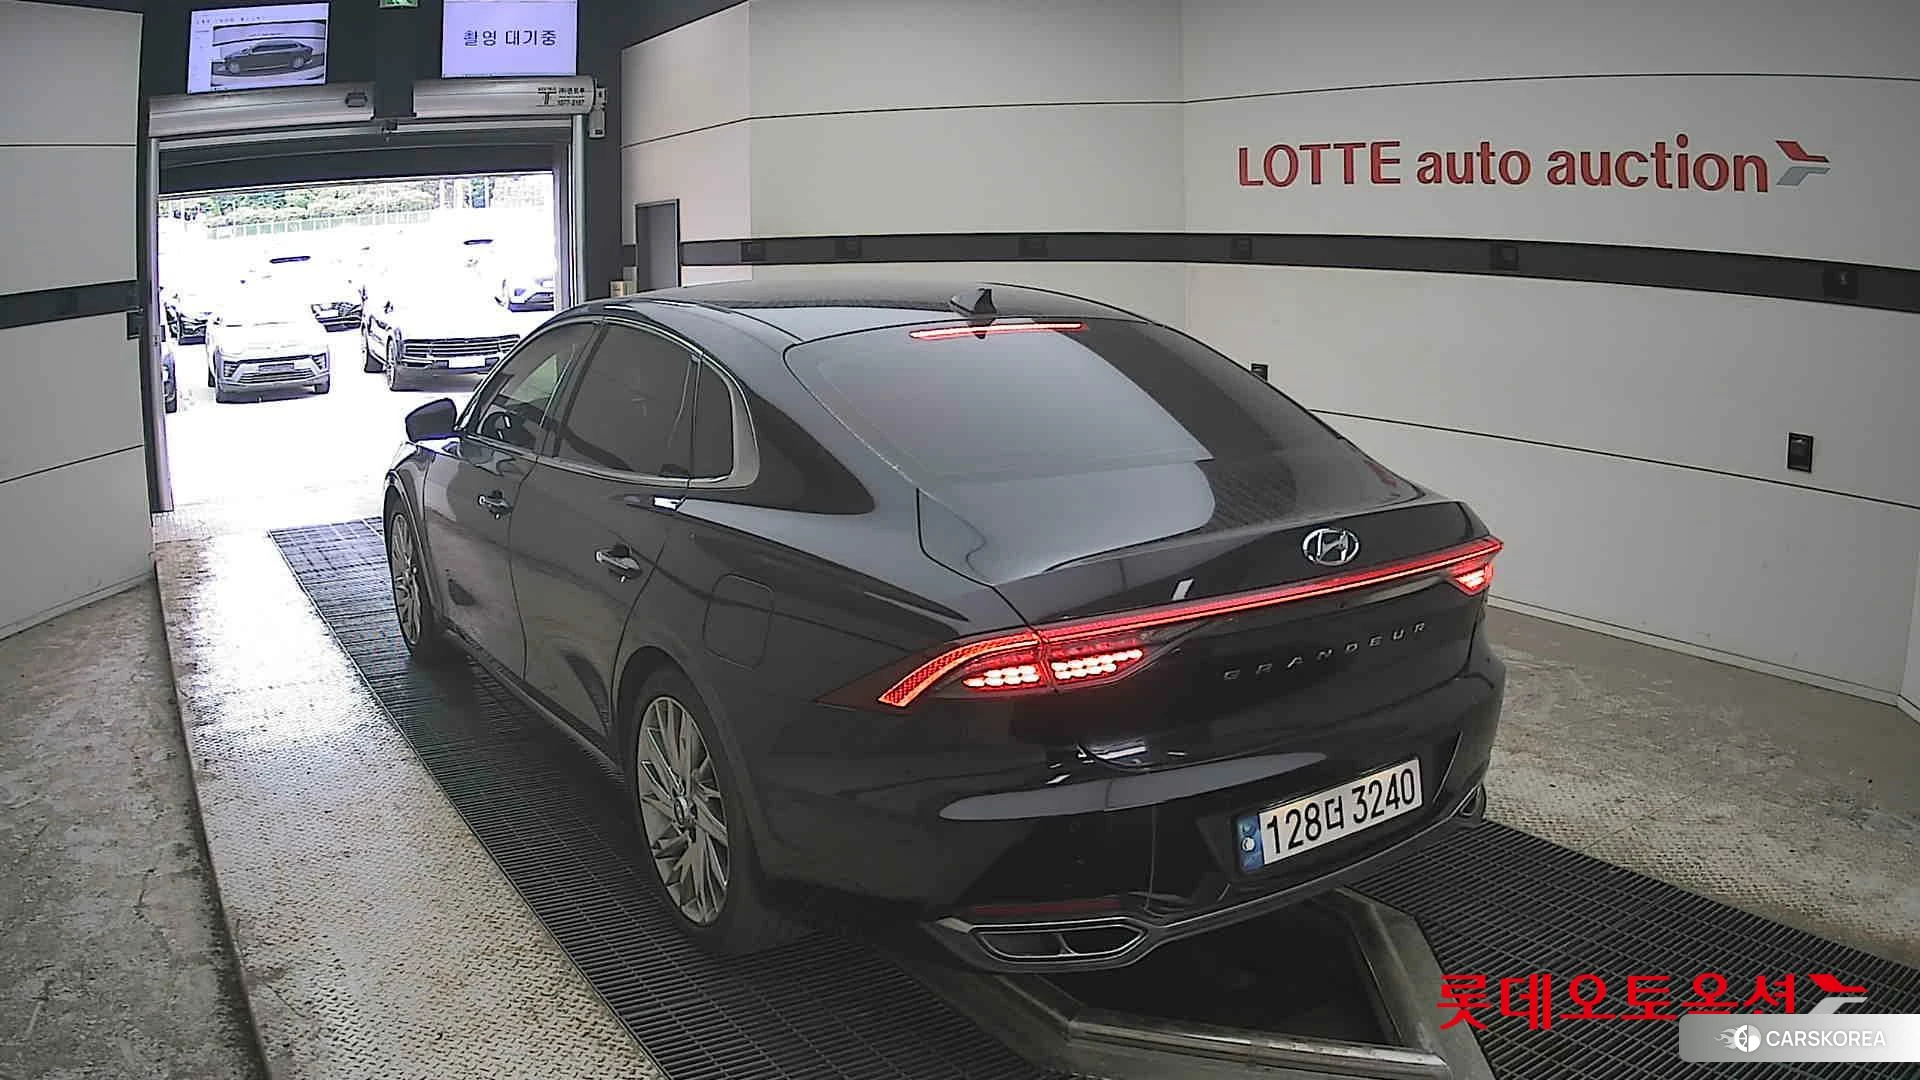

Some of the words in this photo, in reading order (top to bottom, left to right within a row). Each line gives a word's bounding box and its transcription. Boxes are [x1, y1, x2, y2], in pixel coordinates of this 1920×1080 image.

[463, 29, 497, 47] 촬영
[505, 29, 557, 47] 대기중
[1238, 141, 1401, 187] LOTTE
[1416, 141, 1532, 186] auto
[1546, 133, 1769, 193] auction
[1223, 621, 1426, 681] GRANDEUR
[1267, 795, 1345, 855] 128더
[1351, 767, 1416, 824] 3240
